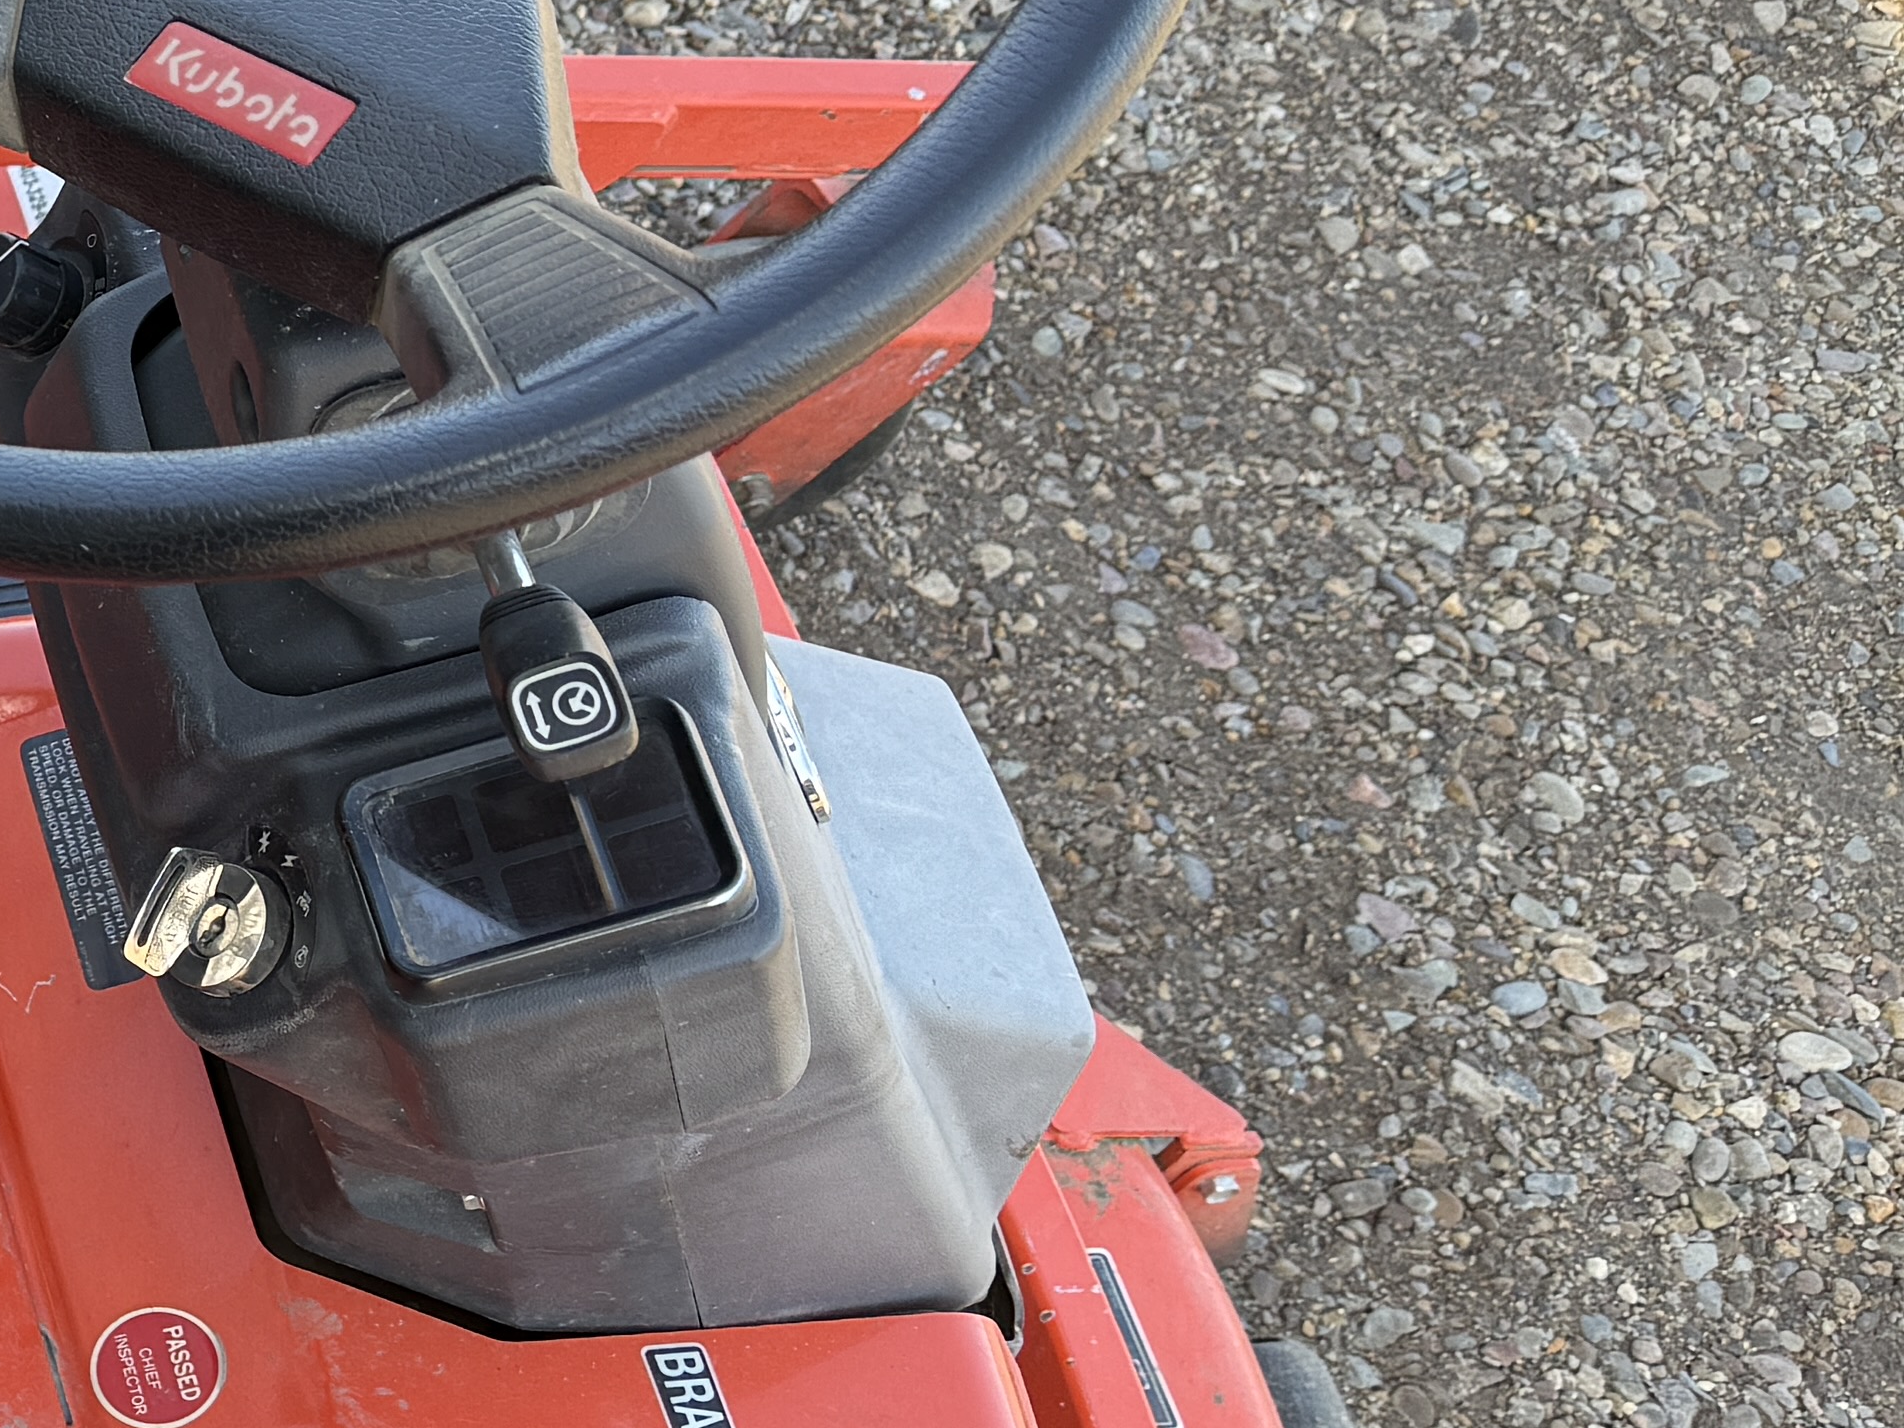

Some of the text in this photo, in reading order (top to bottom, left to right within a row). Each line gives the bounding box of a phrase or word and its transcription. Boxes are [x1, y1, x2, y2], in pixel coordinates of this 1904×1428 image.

[156, 38, 318, 146] Kubota
[28, 748, 61, 840] TRANSMISSION
[54, 843, 70, 869] MAY
[51, 789, 64, 808] OR
[49, 740, 119, 945] LOCK WHEN TRAVELING AT HIGH
[57, 811, 81, 865] DAMAGE
[76, 788, 96, 825] APPLY
[89, 829, 105, 855] THE
[100, 859, 127, 939] DIFFERENTI
[74, 868, 88, 886] TO
[81, 889, 97, 916] THE
[113, 1333, 147, 1415] INSPECTOR
[137, 1347, 162, 1390] CHIEF
[162, 1325, 201, 1401] PASSED
